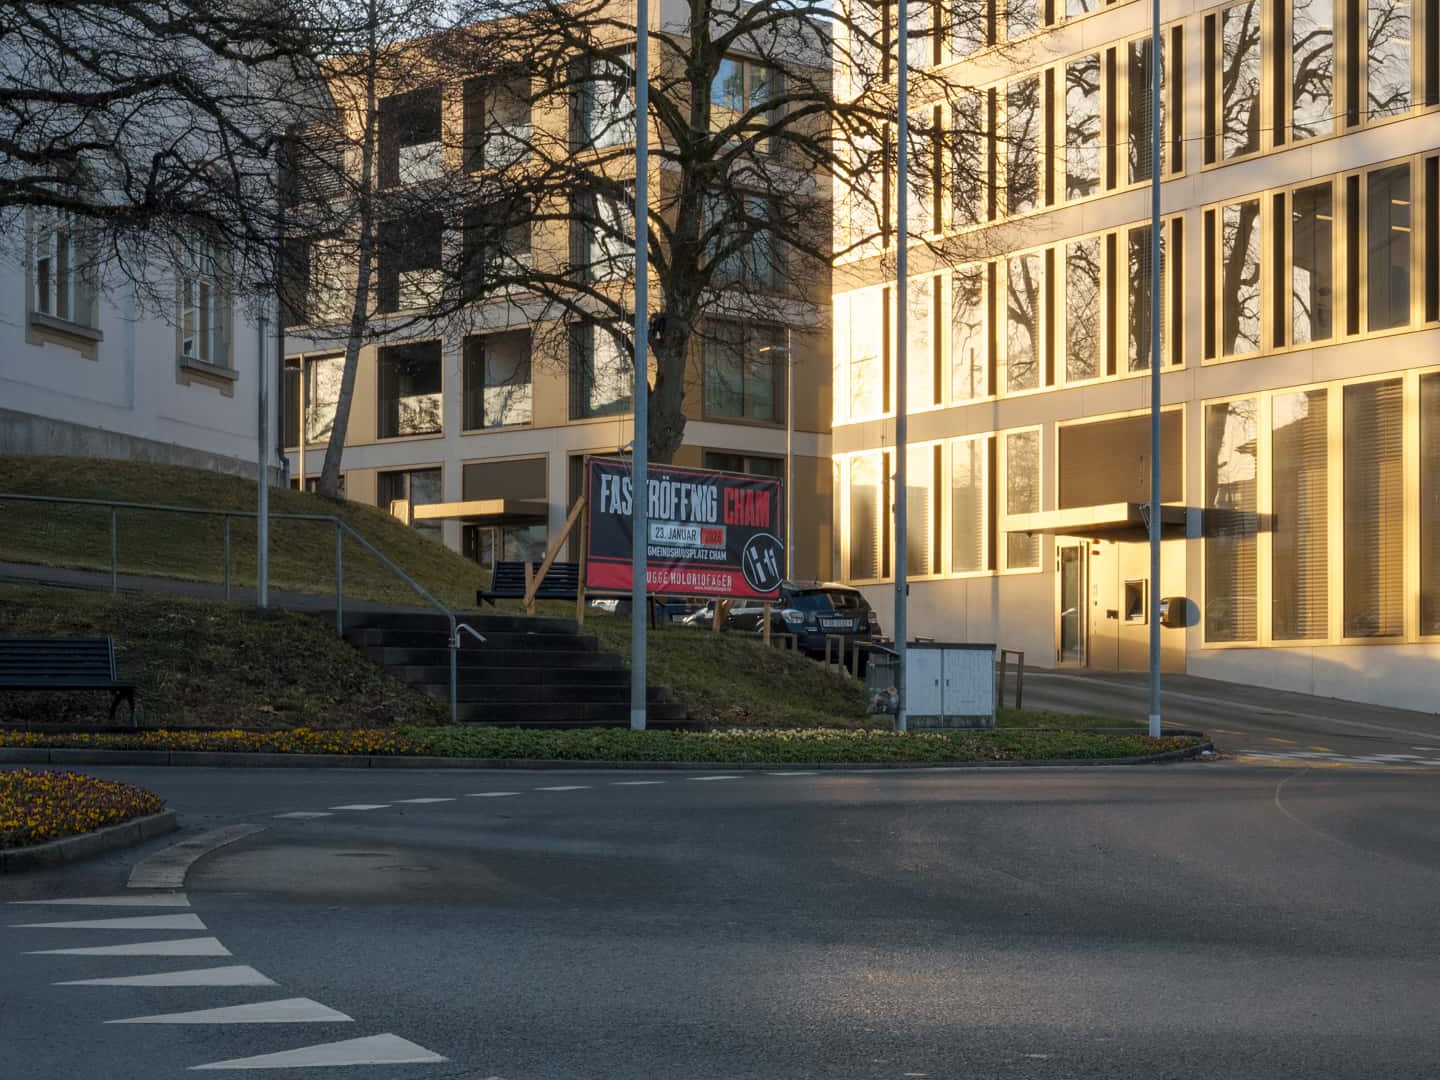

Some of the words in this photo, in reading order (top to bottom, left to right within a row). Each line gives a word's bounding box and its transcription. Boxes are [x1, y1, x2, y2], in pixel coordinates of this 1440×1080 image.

[600, 472, 718, 523] FASRÖFFNIG
[723, 487, 770, 528] CHAM
[655, 527, 666, 539] 23.
[668, 527, 697, 541] JANUAR
[709, 550, 727, 561] CHAM
[646, 571, 669, 584] UGGE
